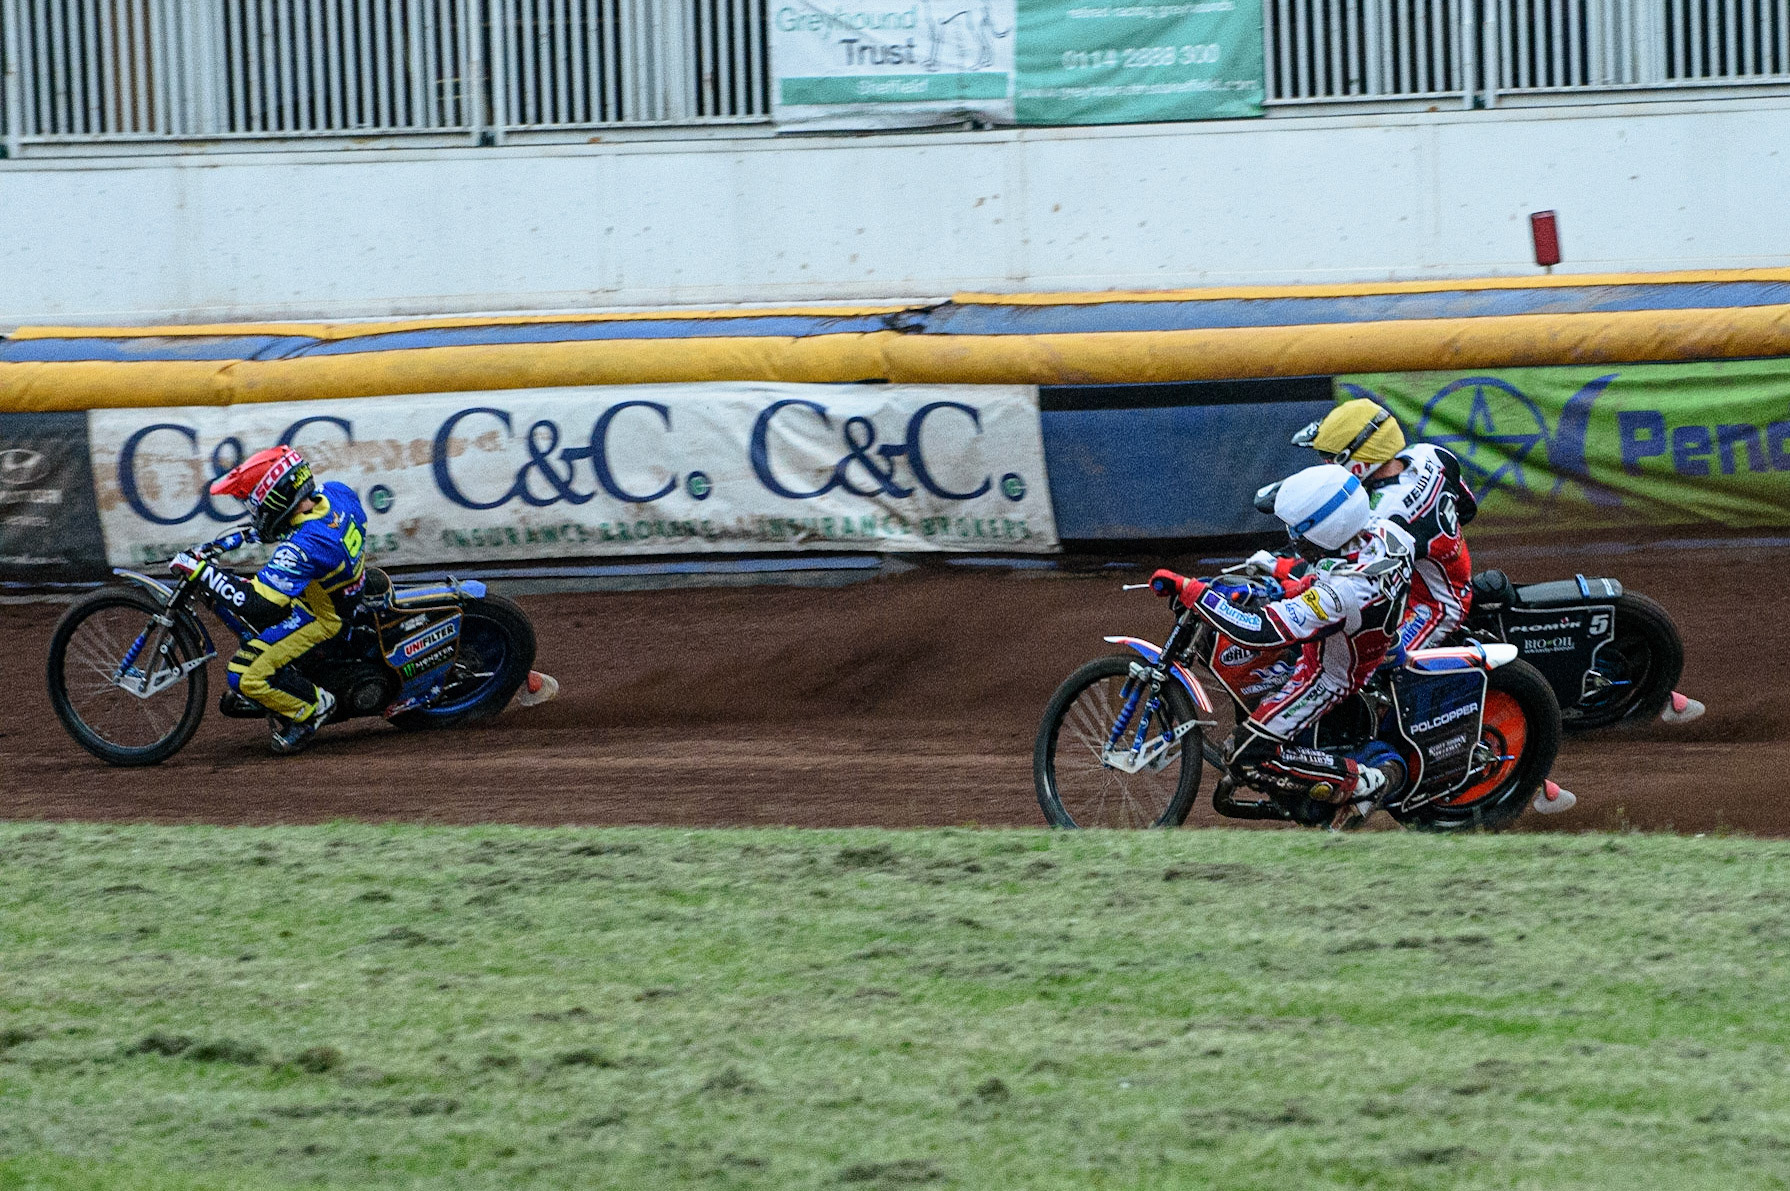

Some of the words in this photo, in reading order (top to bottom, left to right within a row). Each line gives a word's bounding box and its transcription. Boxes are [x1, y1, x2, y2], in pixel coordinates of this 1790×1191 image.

[838, 37, 917, 66] Trust
[1403, 457, 1436, 508] BEWLEY
[201, 565, 246, 608] Nice
[404, 624, 455, 656] UNIFILTER
[1588, 613, 1609, 636] 5
[1410, 702, 1479, 736] POLCOPPER
